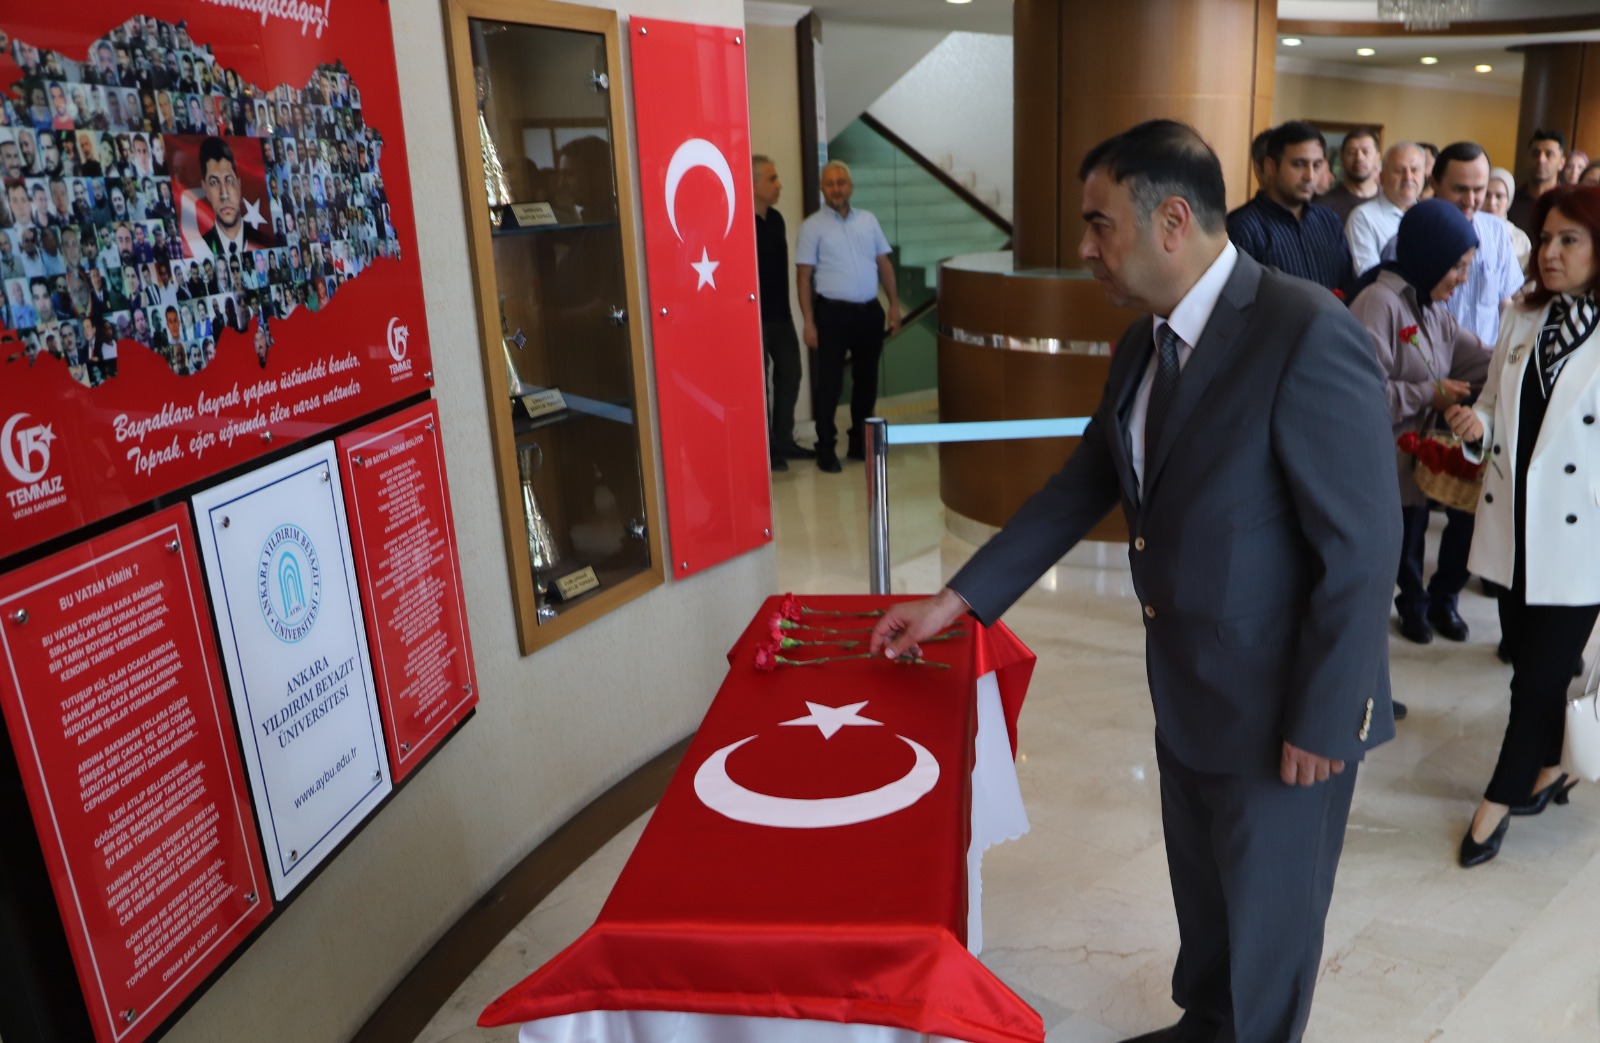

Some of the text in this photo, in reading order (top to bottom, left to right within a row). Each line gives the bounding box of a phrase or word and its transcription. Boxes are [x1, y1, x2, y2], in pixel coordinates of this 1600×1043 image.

[113, 401, 194, 443] Bayrakları
[198, 382, 240, 418] bayrak
[243, 379, 277, 408] yapan
[280, 358, 326, 393] üstündeki
[190, 430, 216, 459] eğer
[219, 409, 267, 448] uğrunda
[270, 401, 290, 424] ölen
[293, 394, 320, 416] varsa
[6, 475, 64, 508] TEMMUZ
[59, 563, 138, 610] BU VATAN KİMİN ?
[260, 527, 319, 617] ANKARA YILDIRIM BEYAZIT
[261, 688, 314, 737] YILDIRIM
[315, 657, 355, 698] BEYAZIT
[286, 655, 329, 697] ANKARA
[277, 680, 349, 749] ÜNİVERSİTESİ
[294, 746, 357, 809] www.aybu.edu.tr
